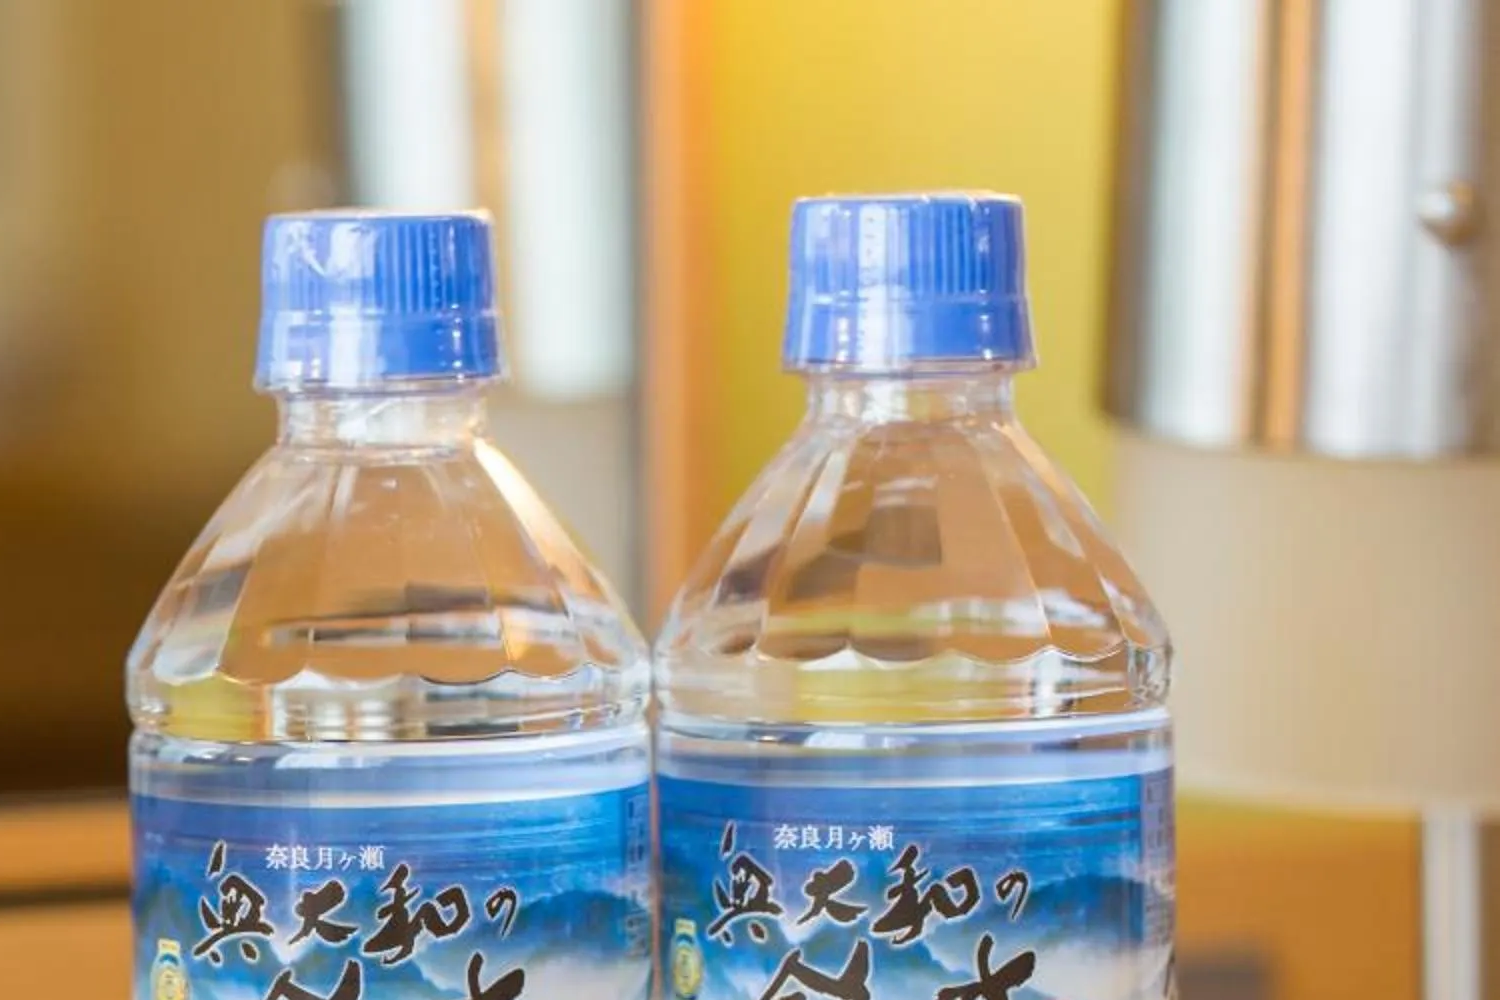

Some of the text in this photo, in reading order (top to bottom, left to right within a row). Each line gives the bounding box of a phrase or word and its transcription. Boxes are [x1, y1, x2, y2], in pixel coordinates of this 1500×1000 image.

[773, 824, 894, 850] 奈良月ヶ瀬
[265, 843, 386, 871] 奈良月ヶ瀬
